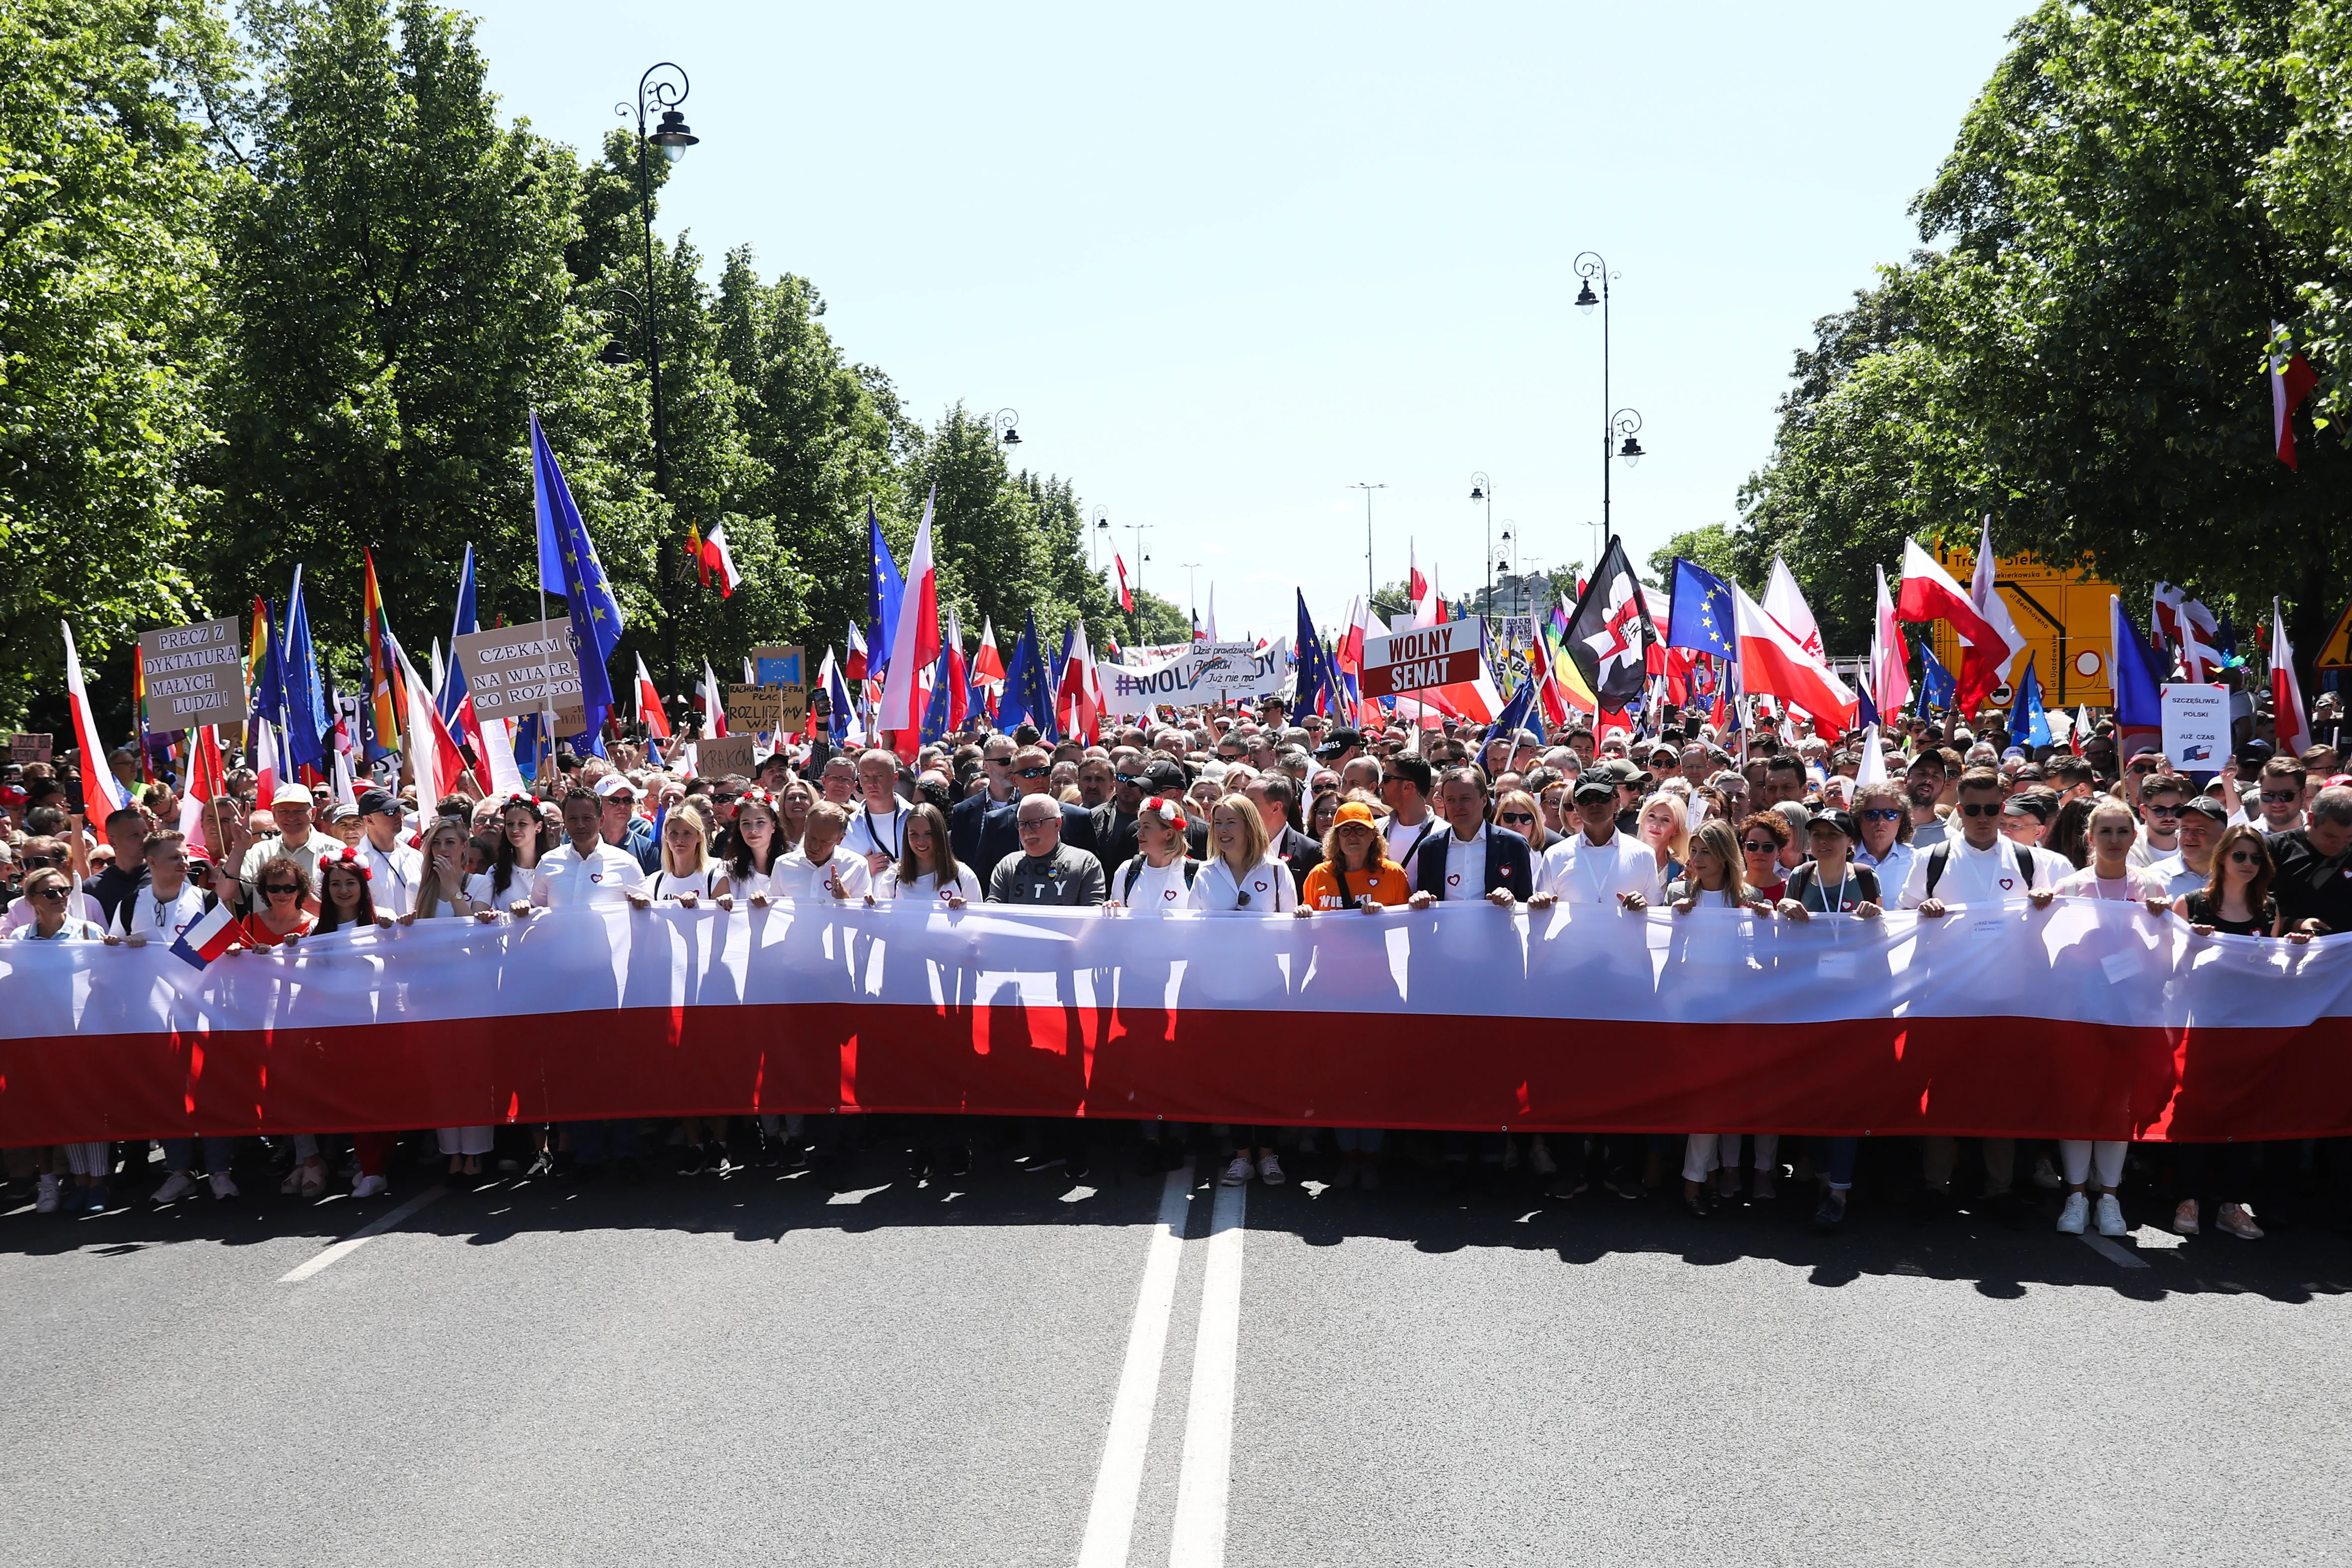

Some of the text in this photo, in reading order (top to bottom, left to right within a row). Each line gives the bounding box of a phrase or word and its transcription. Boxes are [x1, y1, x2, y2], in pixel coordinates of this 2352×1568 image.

[1954, 554, 1977, 567] Tra
[160, 625, 224, 649] PRECZ Z
[1389, 627, 1452, 663] WOLNY
[145, 646, 237, 674] DYKTATURĄ
[480, 639, 560, 662] CZEKAM
[1193, 644, 1254, 659] Dziś prawdziwych
[152, 674, 215, 697] MAŁYCH
[473, 675, 500, 689] NA
[1115, 664, 1190, 696] #WOL
[1206, 672, 1222, 683] Już
[1225, 671, 1239, 682] nie
[1392, 657, 1450, 692] SENAT
[475, 679, 583, 708] CO ROZGON
[729, 685, 766, 694] RACHUNKI
[1328, 740, 1340, 749] OSS
[702, 745, 752, 772] KRAKÓW
[1319, 894, 1372, 908] WIEKI
